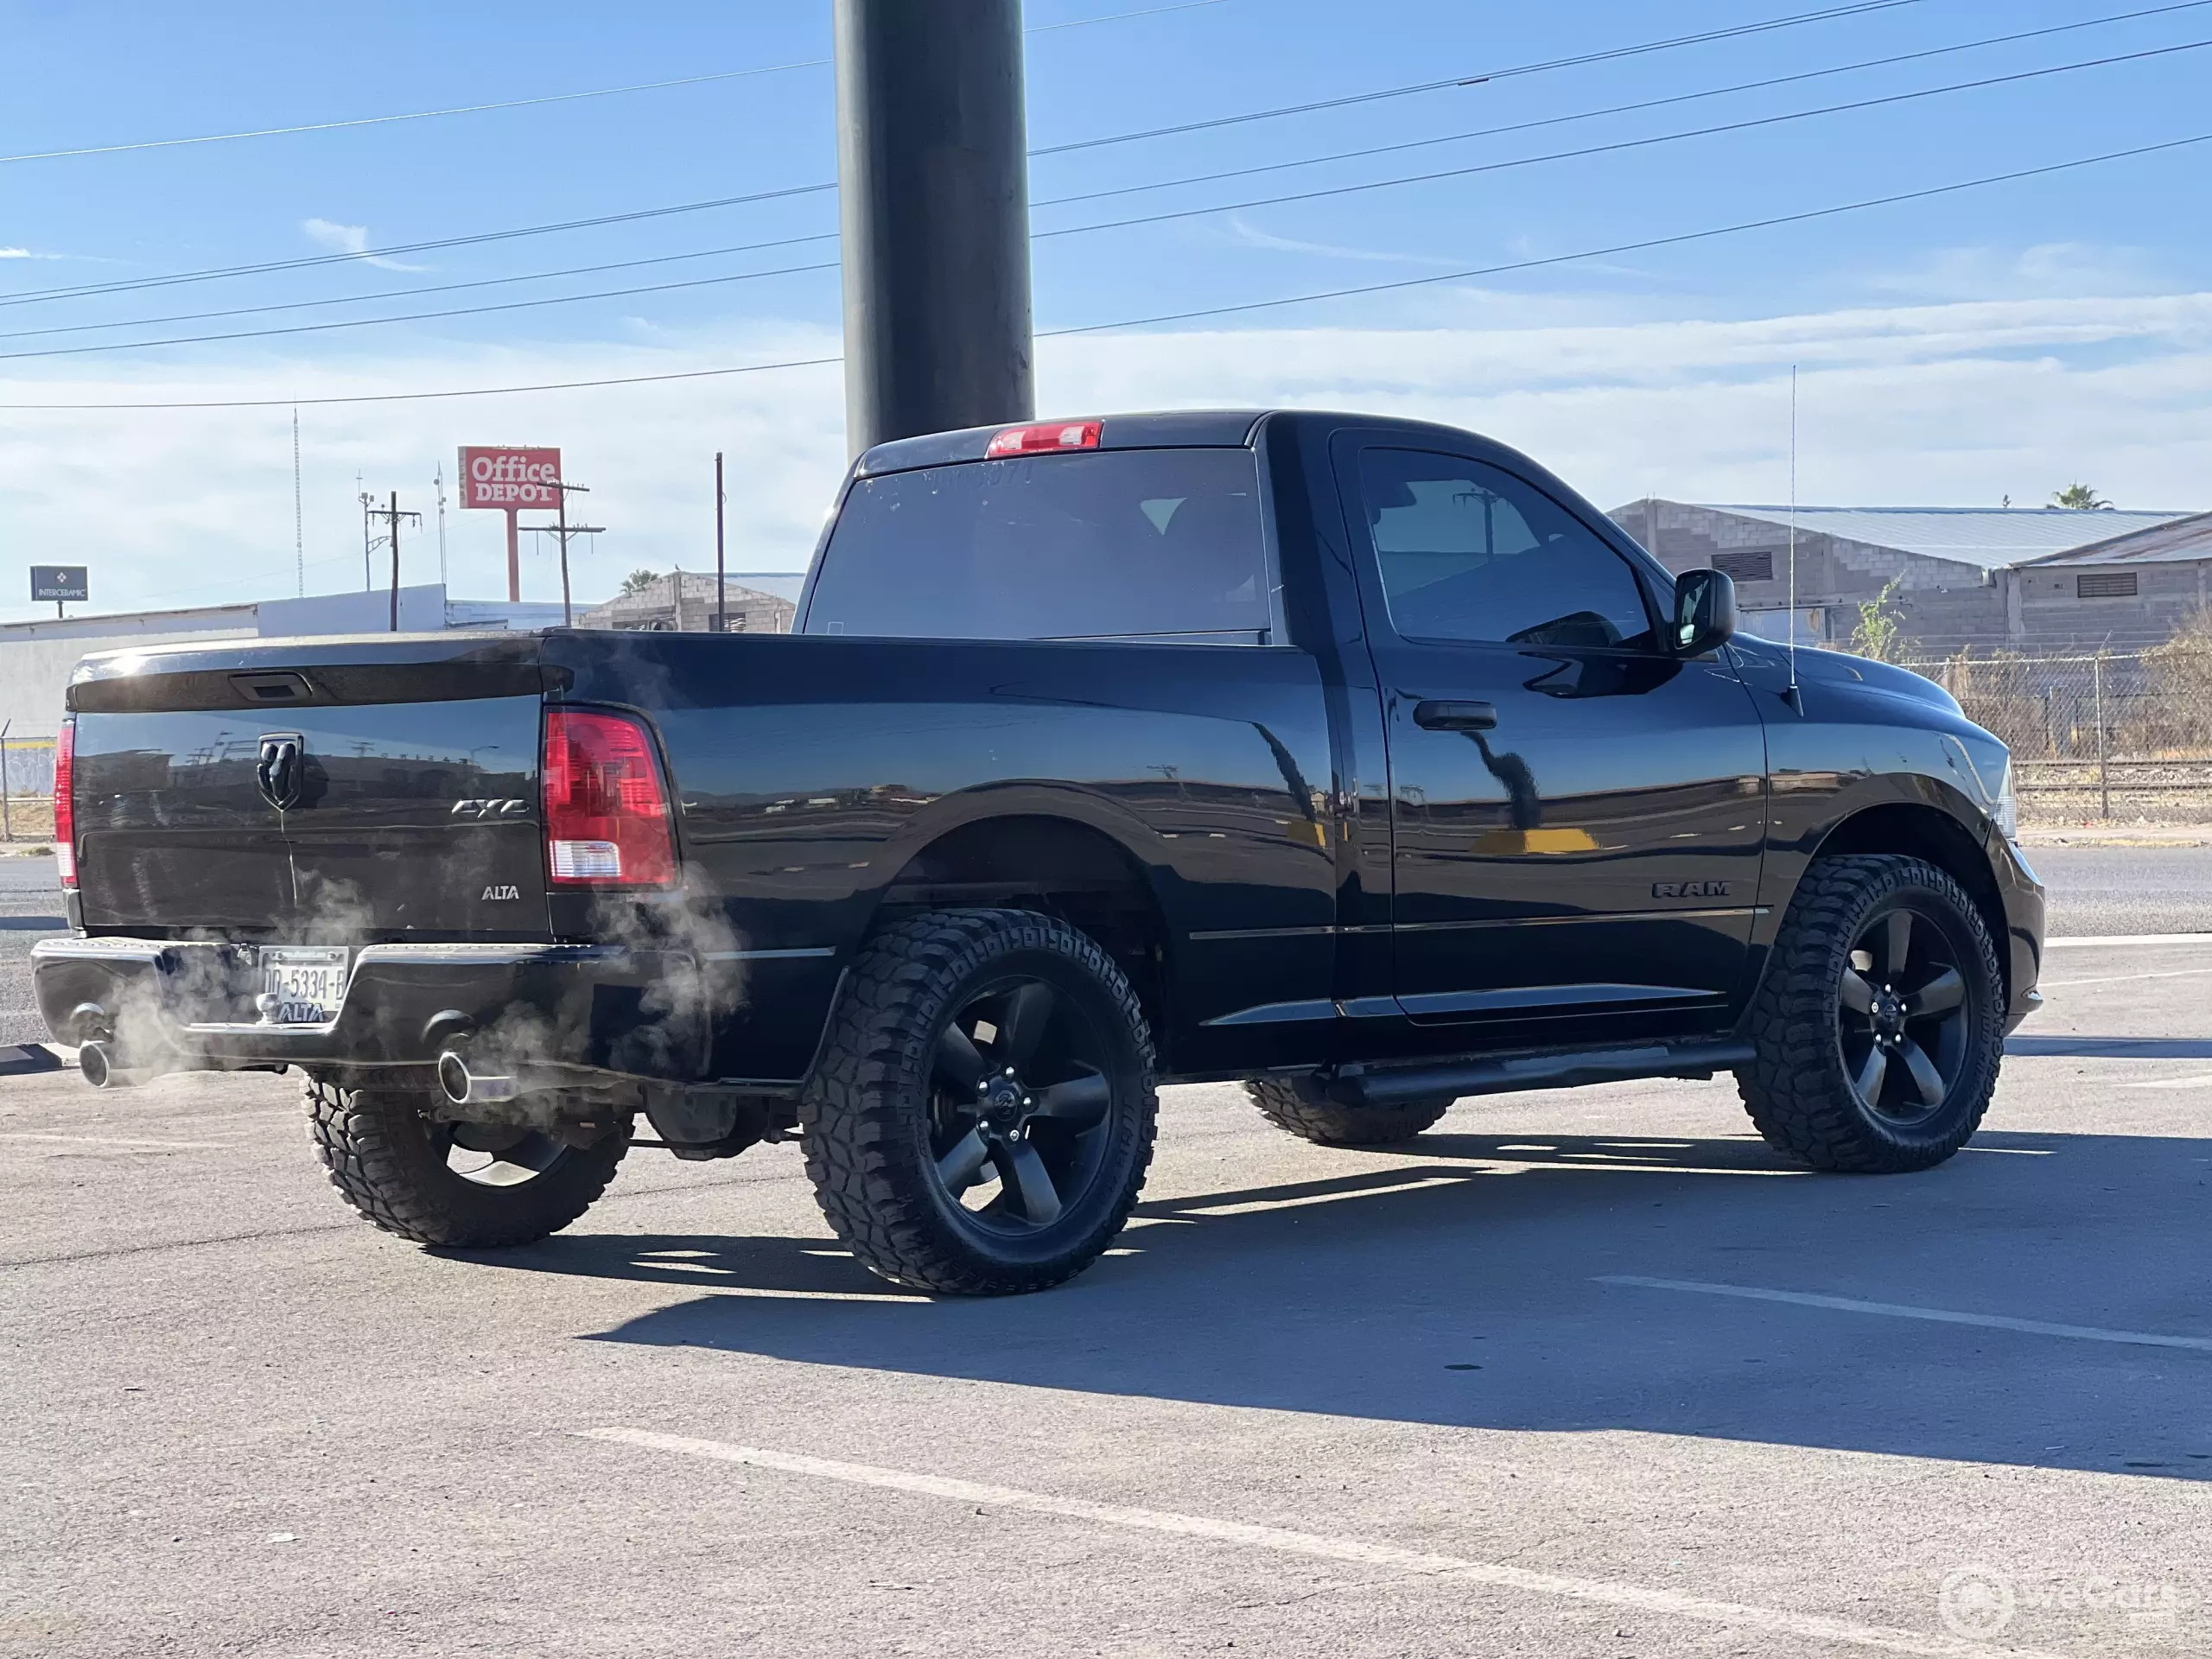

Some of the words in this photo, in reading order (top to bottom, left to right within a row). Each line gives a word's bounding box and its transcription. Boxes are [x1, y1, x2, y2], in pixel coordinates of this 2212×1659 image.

[472, 455, 556, 482] Office
[475, 482, 552, 502] DEPOT
[38, 588, 86, 597] INTERCERAMIC
[481, 885, 520, 900] ALTA
[1651, 880, 1732, 899] RAM
[276, 1001, 325, 1022] ALTA
